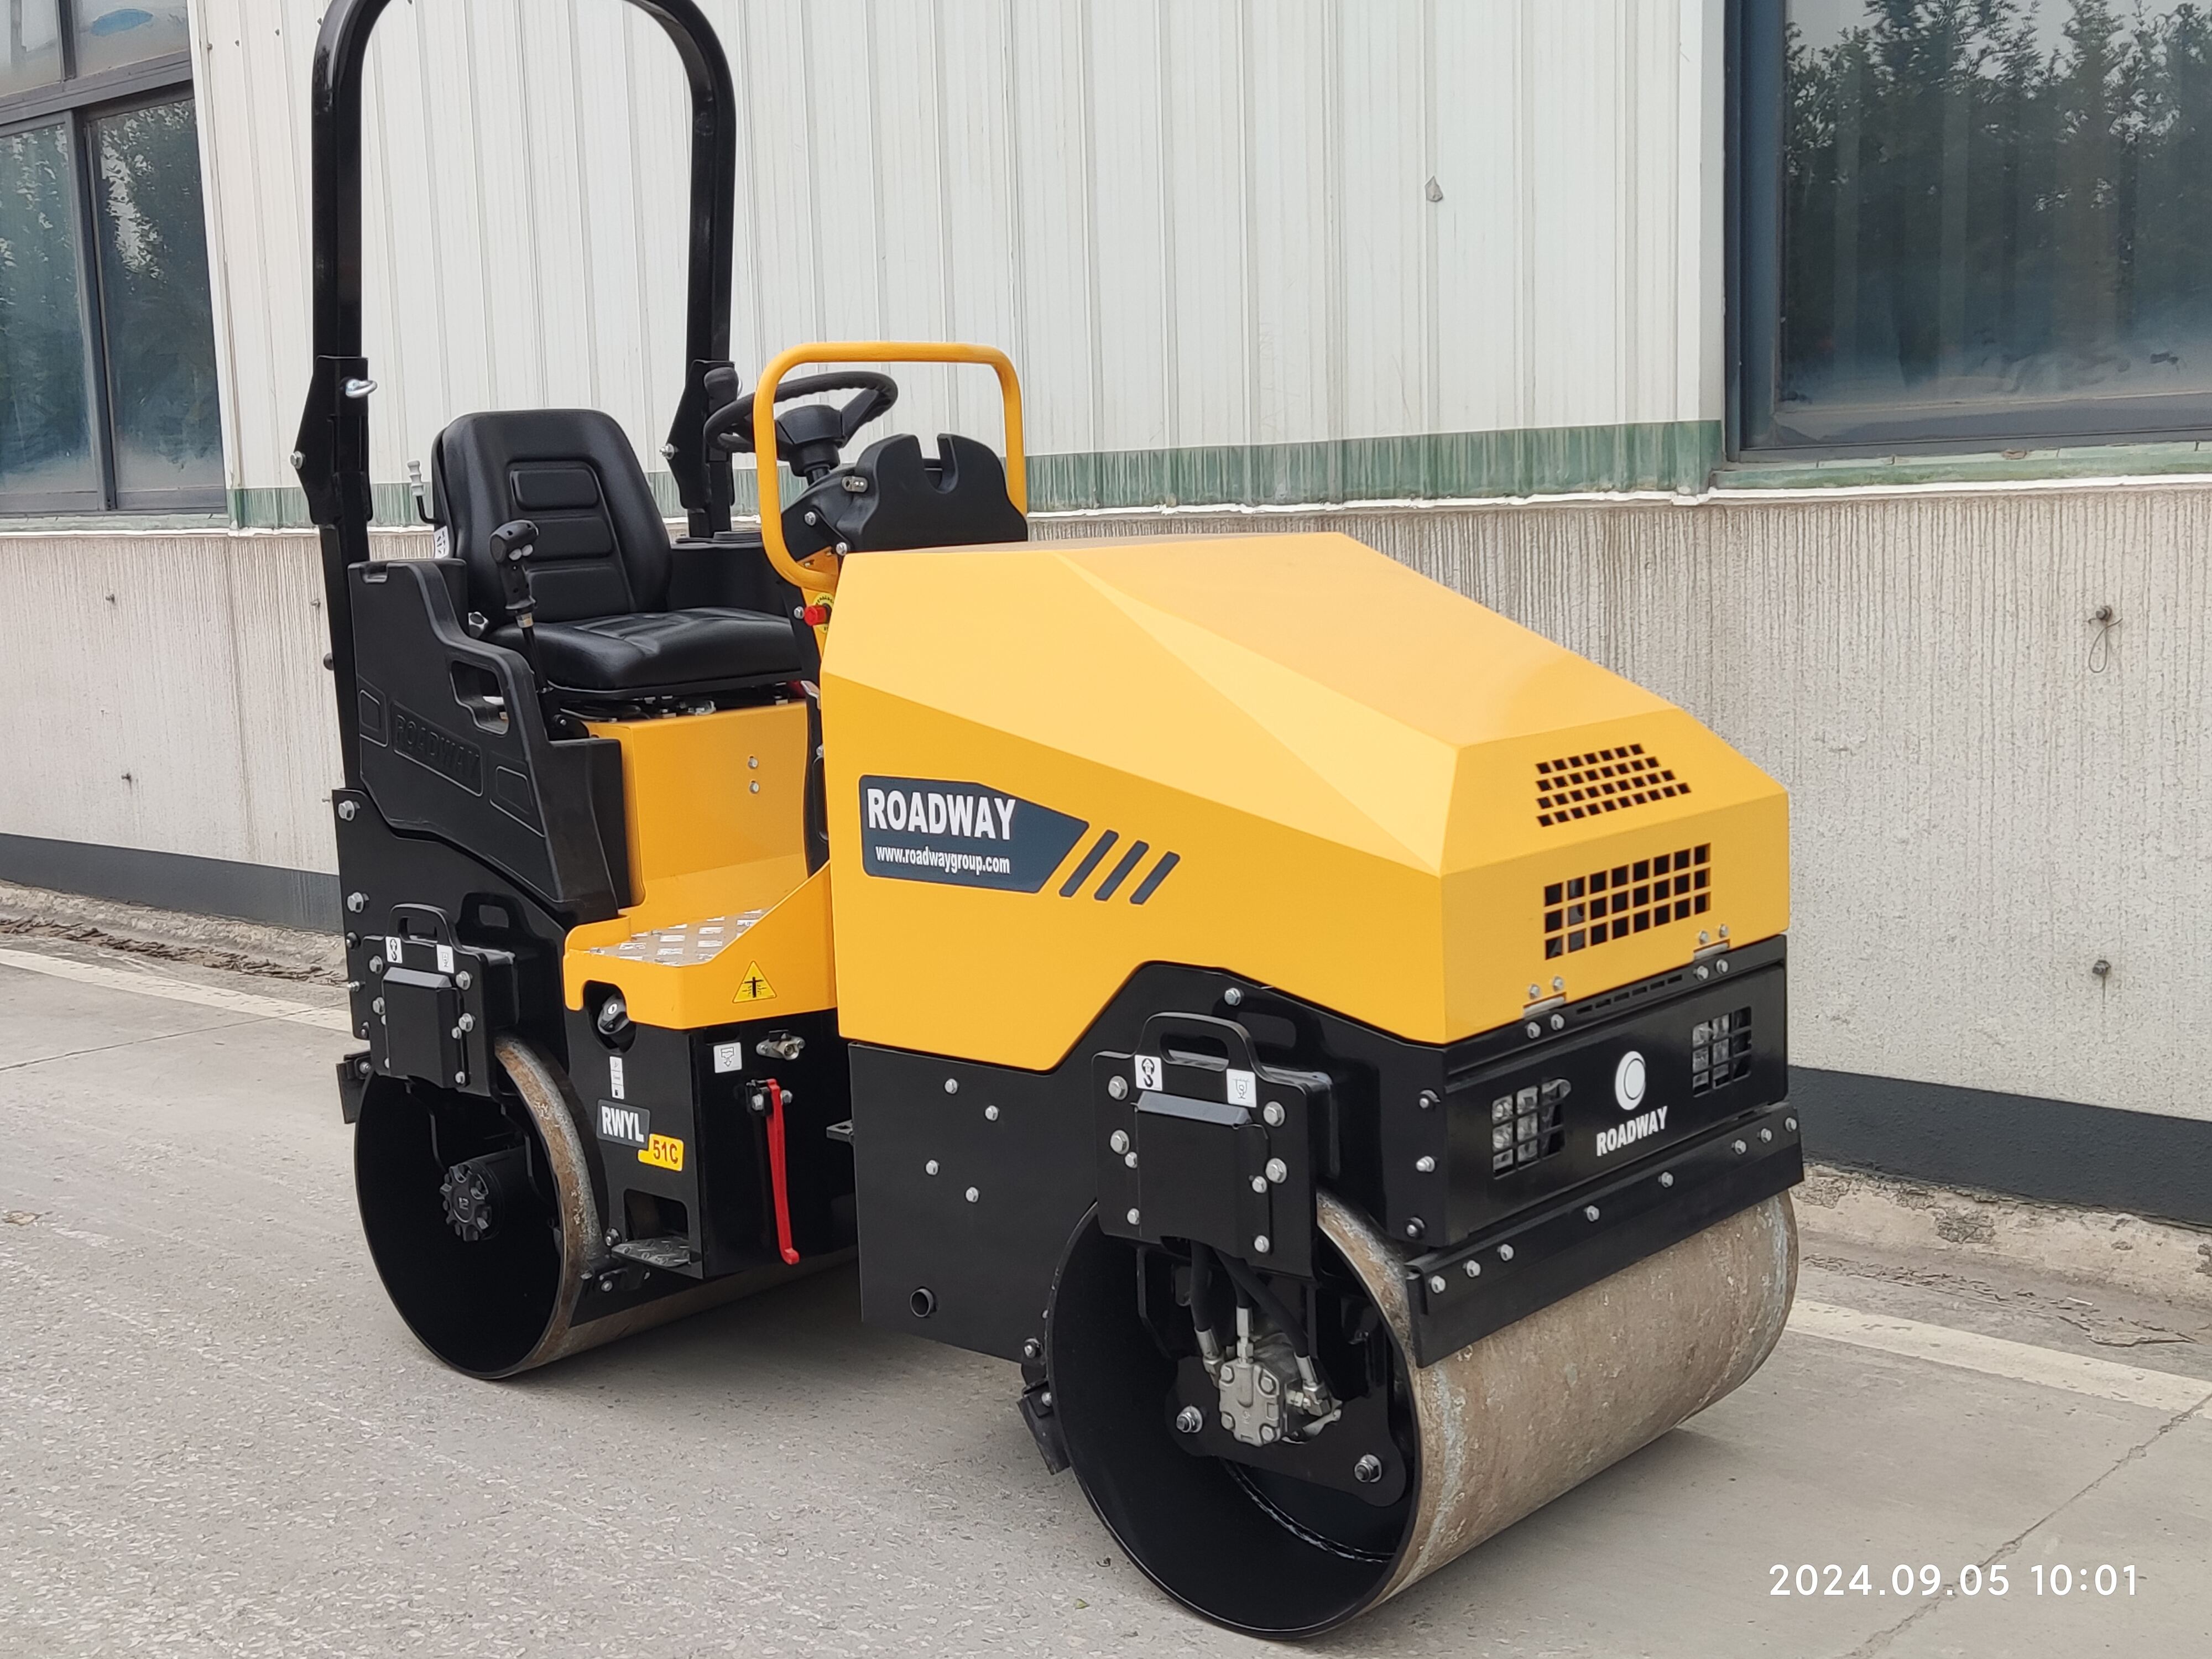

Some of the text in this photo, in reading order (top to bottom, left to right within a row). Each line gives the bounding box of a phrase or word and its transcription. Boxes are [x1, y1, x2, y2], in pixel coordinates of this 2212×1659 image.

[867, 789, 1016, 840] ROADWAY
[875, 846, 1010, 875] www.roadwaygroup.com
[601, 1105, 645, 1143] RWYL
[1596, 1105, 1668, 1156] ROADWAY
[653, 1139, 679, 1164] 51C
